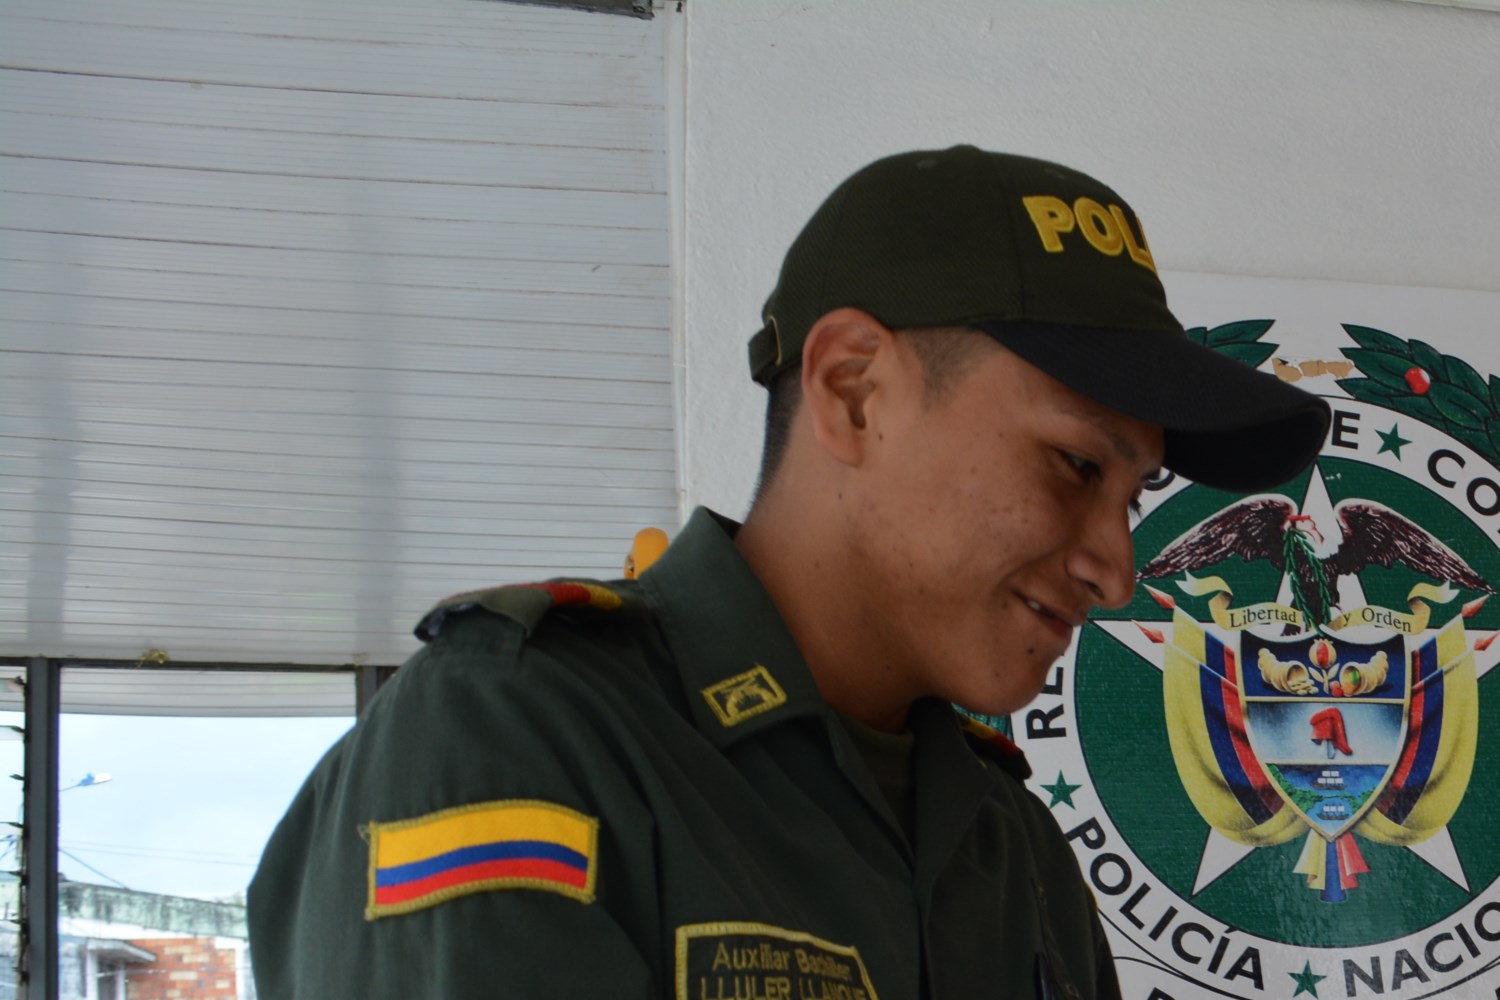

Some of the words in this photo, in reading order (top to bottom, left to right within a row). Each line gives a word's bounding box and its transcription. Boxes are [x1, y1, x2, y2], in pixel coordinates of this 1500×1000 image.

[1022, 195, 1157, 273] POL
[1230, 607, 1297, 628] Libertad
[1343, 612, 1351, 627] y
[1361, 607, 1412, 633] Orden
[1064, 816, 1265, 991] POLICÍA
